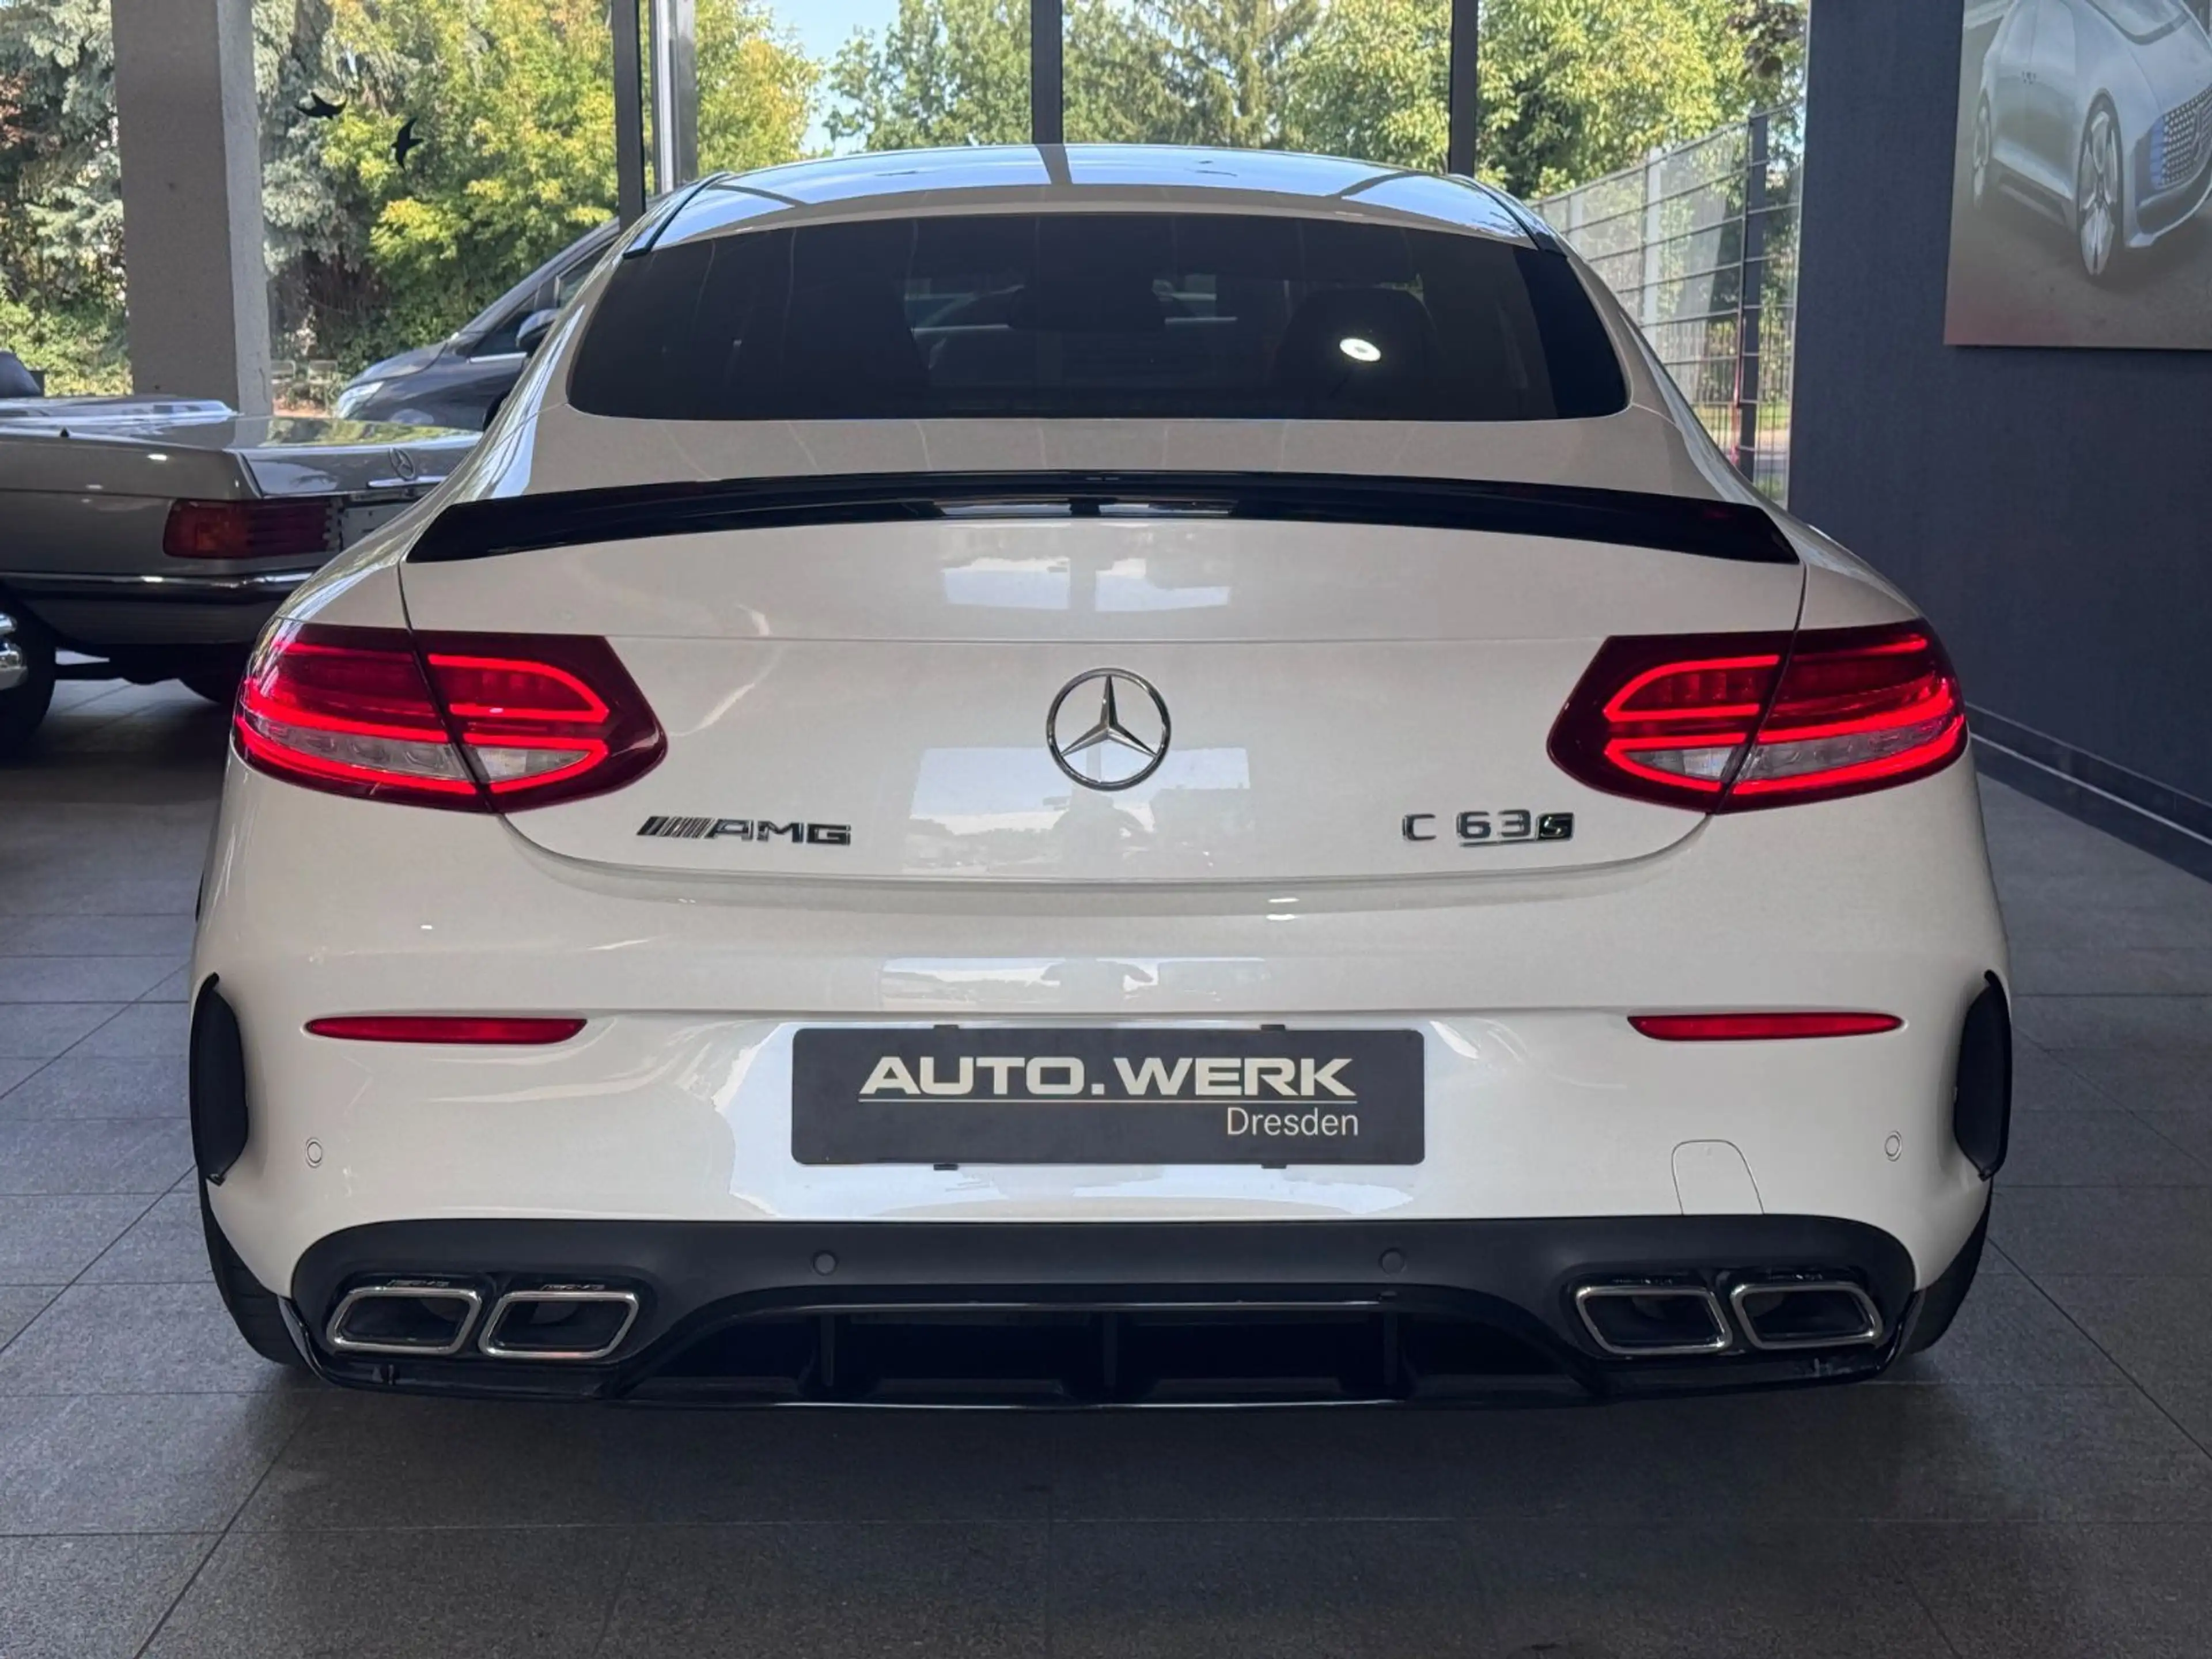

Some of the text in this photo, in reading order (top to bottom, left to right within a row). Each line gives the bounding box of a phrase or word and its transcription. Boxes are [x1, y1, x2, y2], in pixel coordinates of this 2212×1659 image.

[704, 819, 851, 846] AMG
[1402, 813, 1437, 841] C
[859, 1056, 1356, 1096] AUTO.WERK
[1227, 1107, 1359, 1137] Dresden
